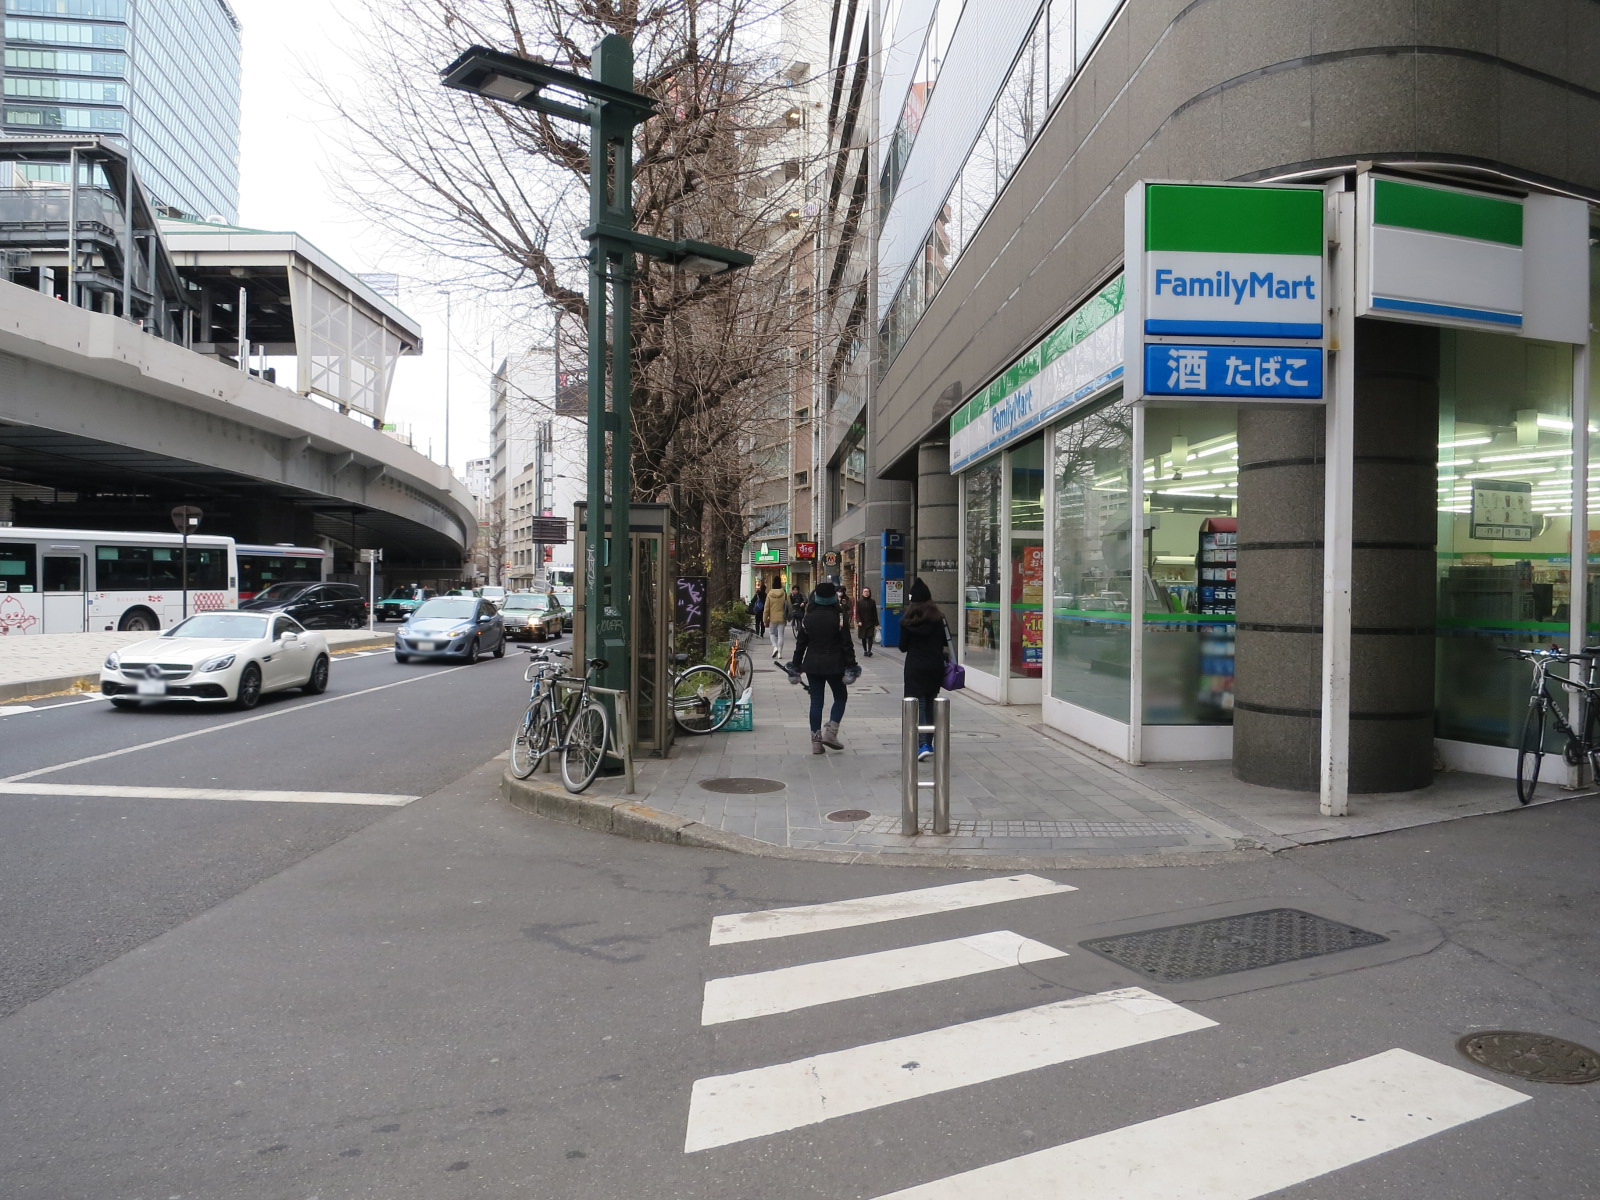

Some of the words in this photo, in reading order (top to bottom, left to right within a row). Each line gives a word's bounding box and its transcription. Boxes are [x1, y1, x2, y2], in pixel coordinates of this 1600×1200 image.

[1155, 269, 1316, 305] FamilyMart
[1166, 349, 1208, 391] 酒
[1225, 355, 1309, 388] たばこ
[991, 384, 1033, 435] FamilyMart
[889, 534, 900, 546] P
